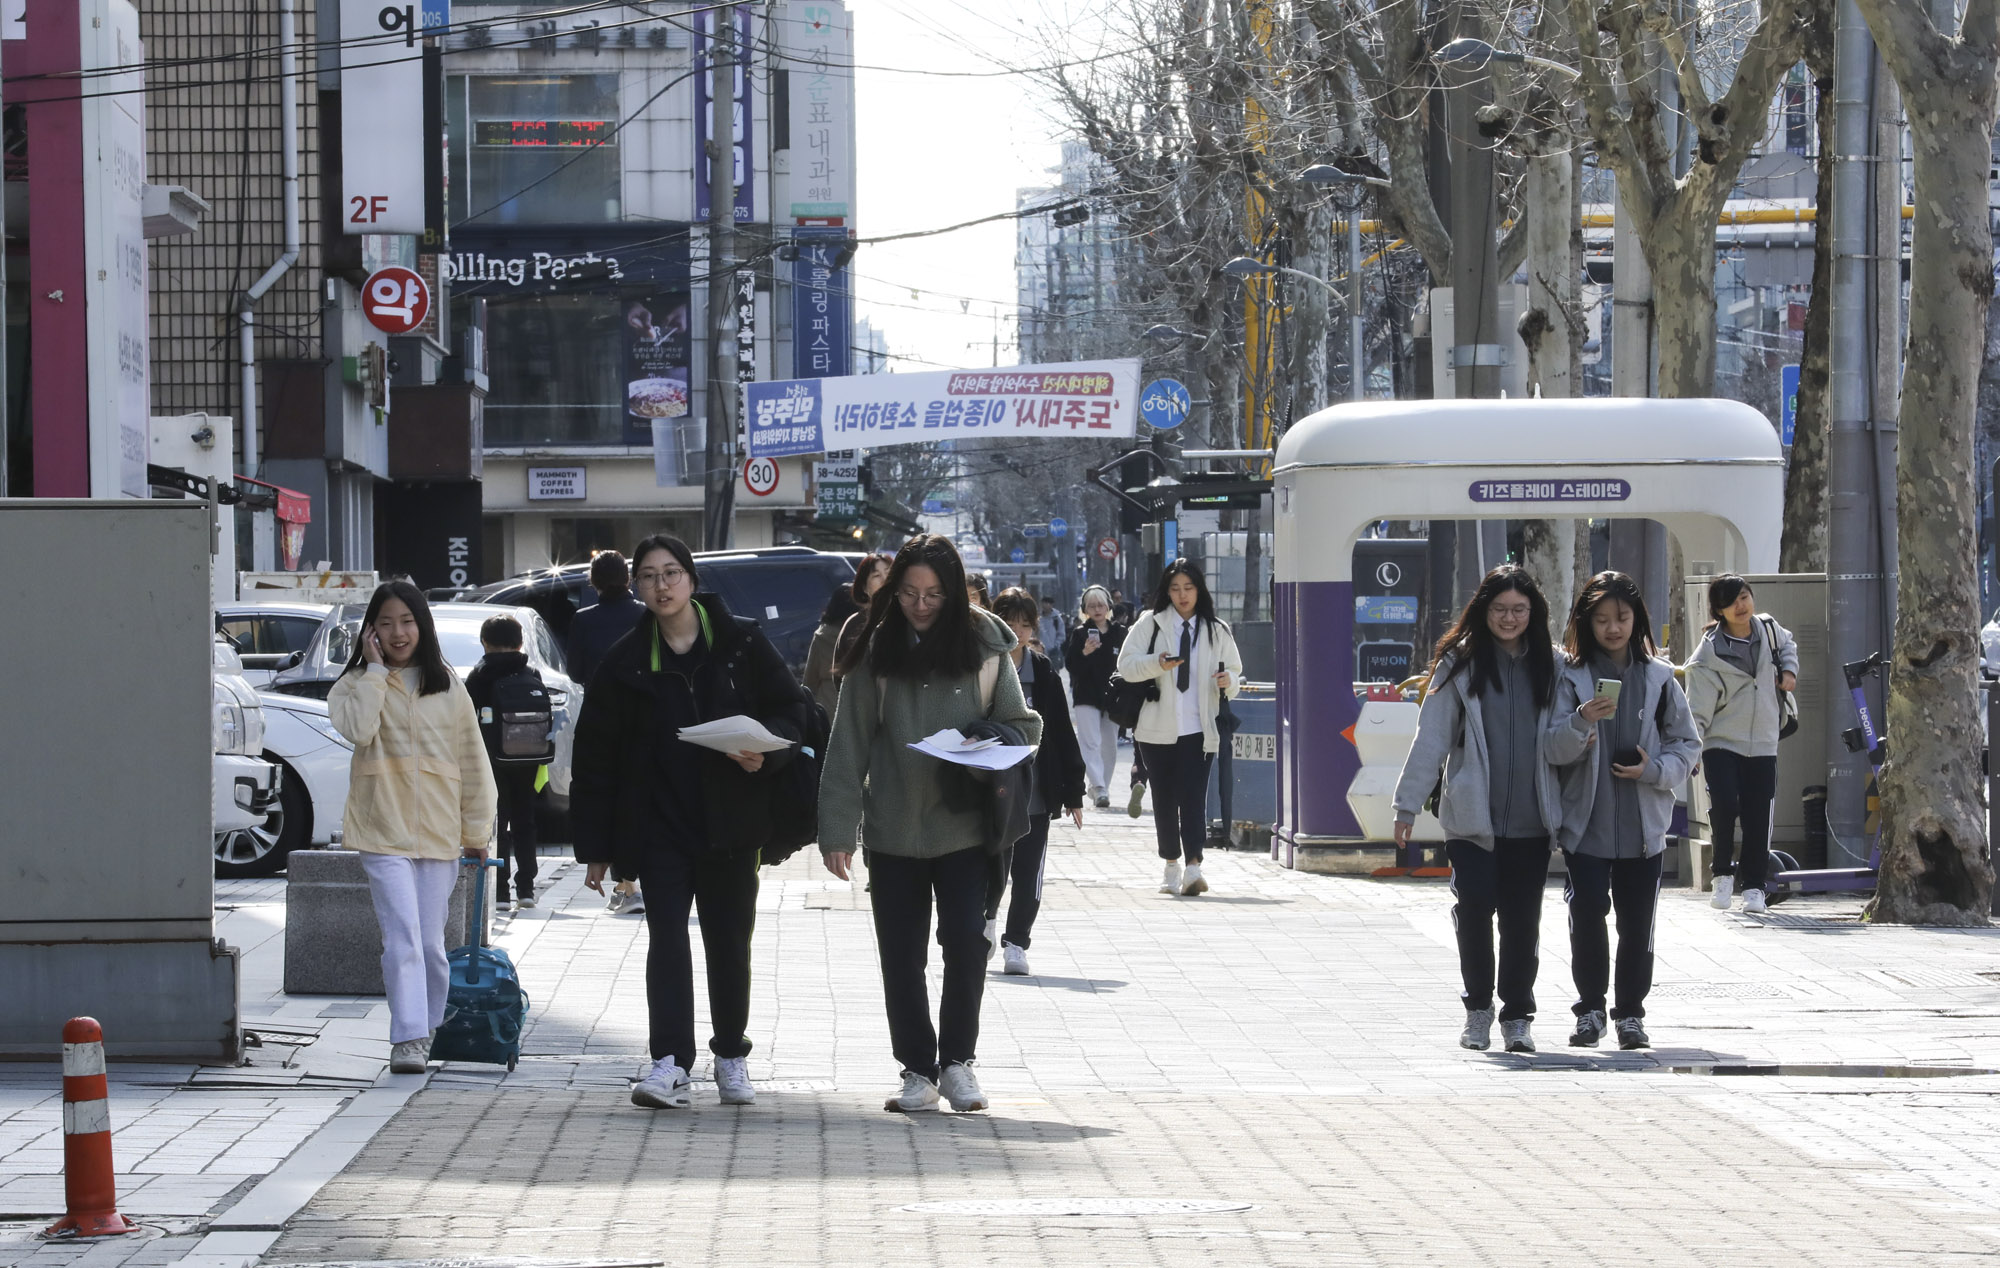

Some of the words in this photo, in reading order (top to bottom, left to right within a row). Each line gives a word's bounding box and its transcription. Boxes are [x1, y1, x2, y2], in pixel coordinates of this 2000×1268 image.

[351, 196, 388, 223] 2F
[371, 278, 420, 326] 약
[751, 464, 772, 484] 30
[1479, 483, 1555, 498] 키즈플레이
[1561, 483, 1621, 498] 스테이션
[1859, 706, 1873, 737] beam
